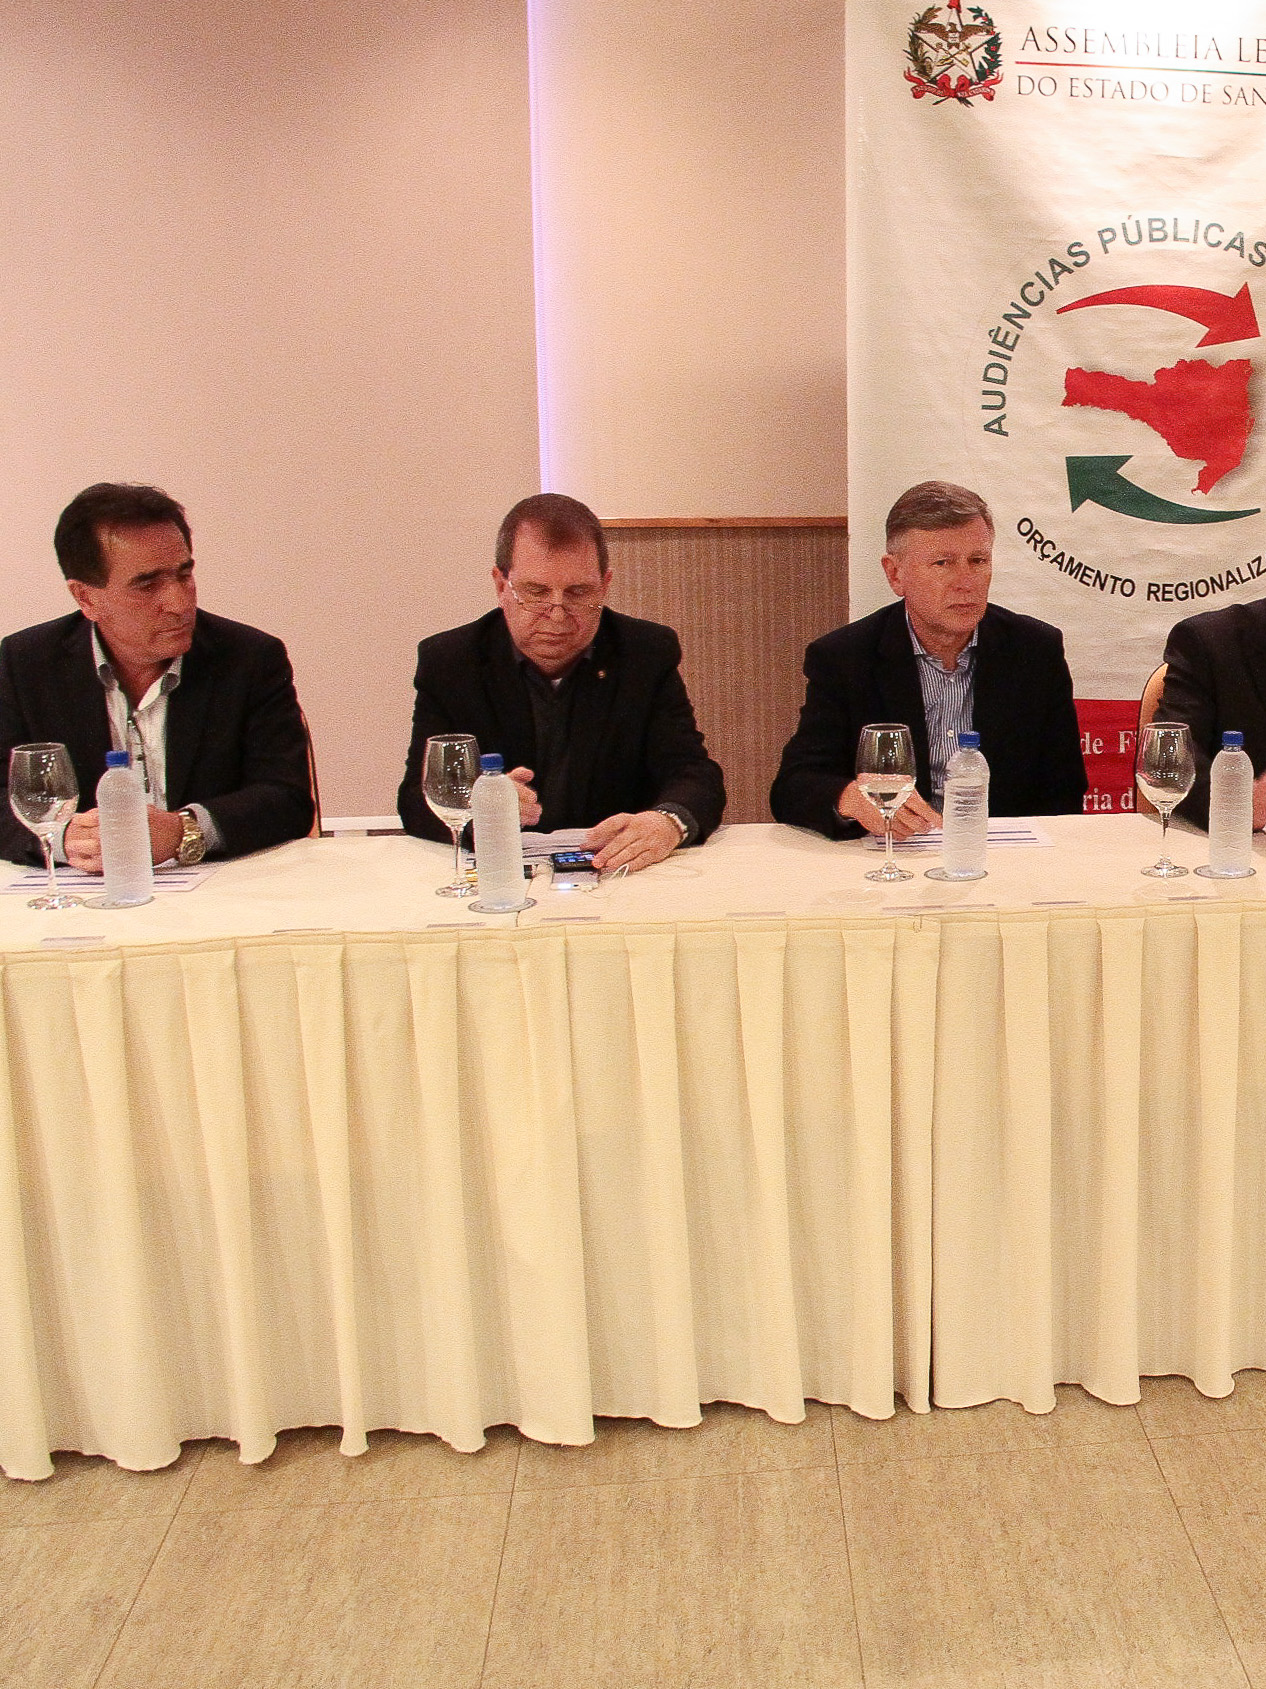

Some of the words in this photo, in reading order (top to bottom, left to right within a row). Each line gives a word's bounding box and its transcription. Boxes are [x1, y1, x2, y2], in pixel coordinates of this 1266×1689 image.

[1019, 26, 1223, 61] ASSEMBLEIA
[1017, 75, 1057, 97] DO
[1069, 77, 1169, 101] ESTADO
[1181, 83, 1212, 104] DE
[981, 241, 1091, 437] AUDIÊNCIAS
[1017, 517, 1136, 597] ORÇAMENTO
[1080, 731, 1104, 755] de
